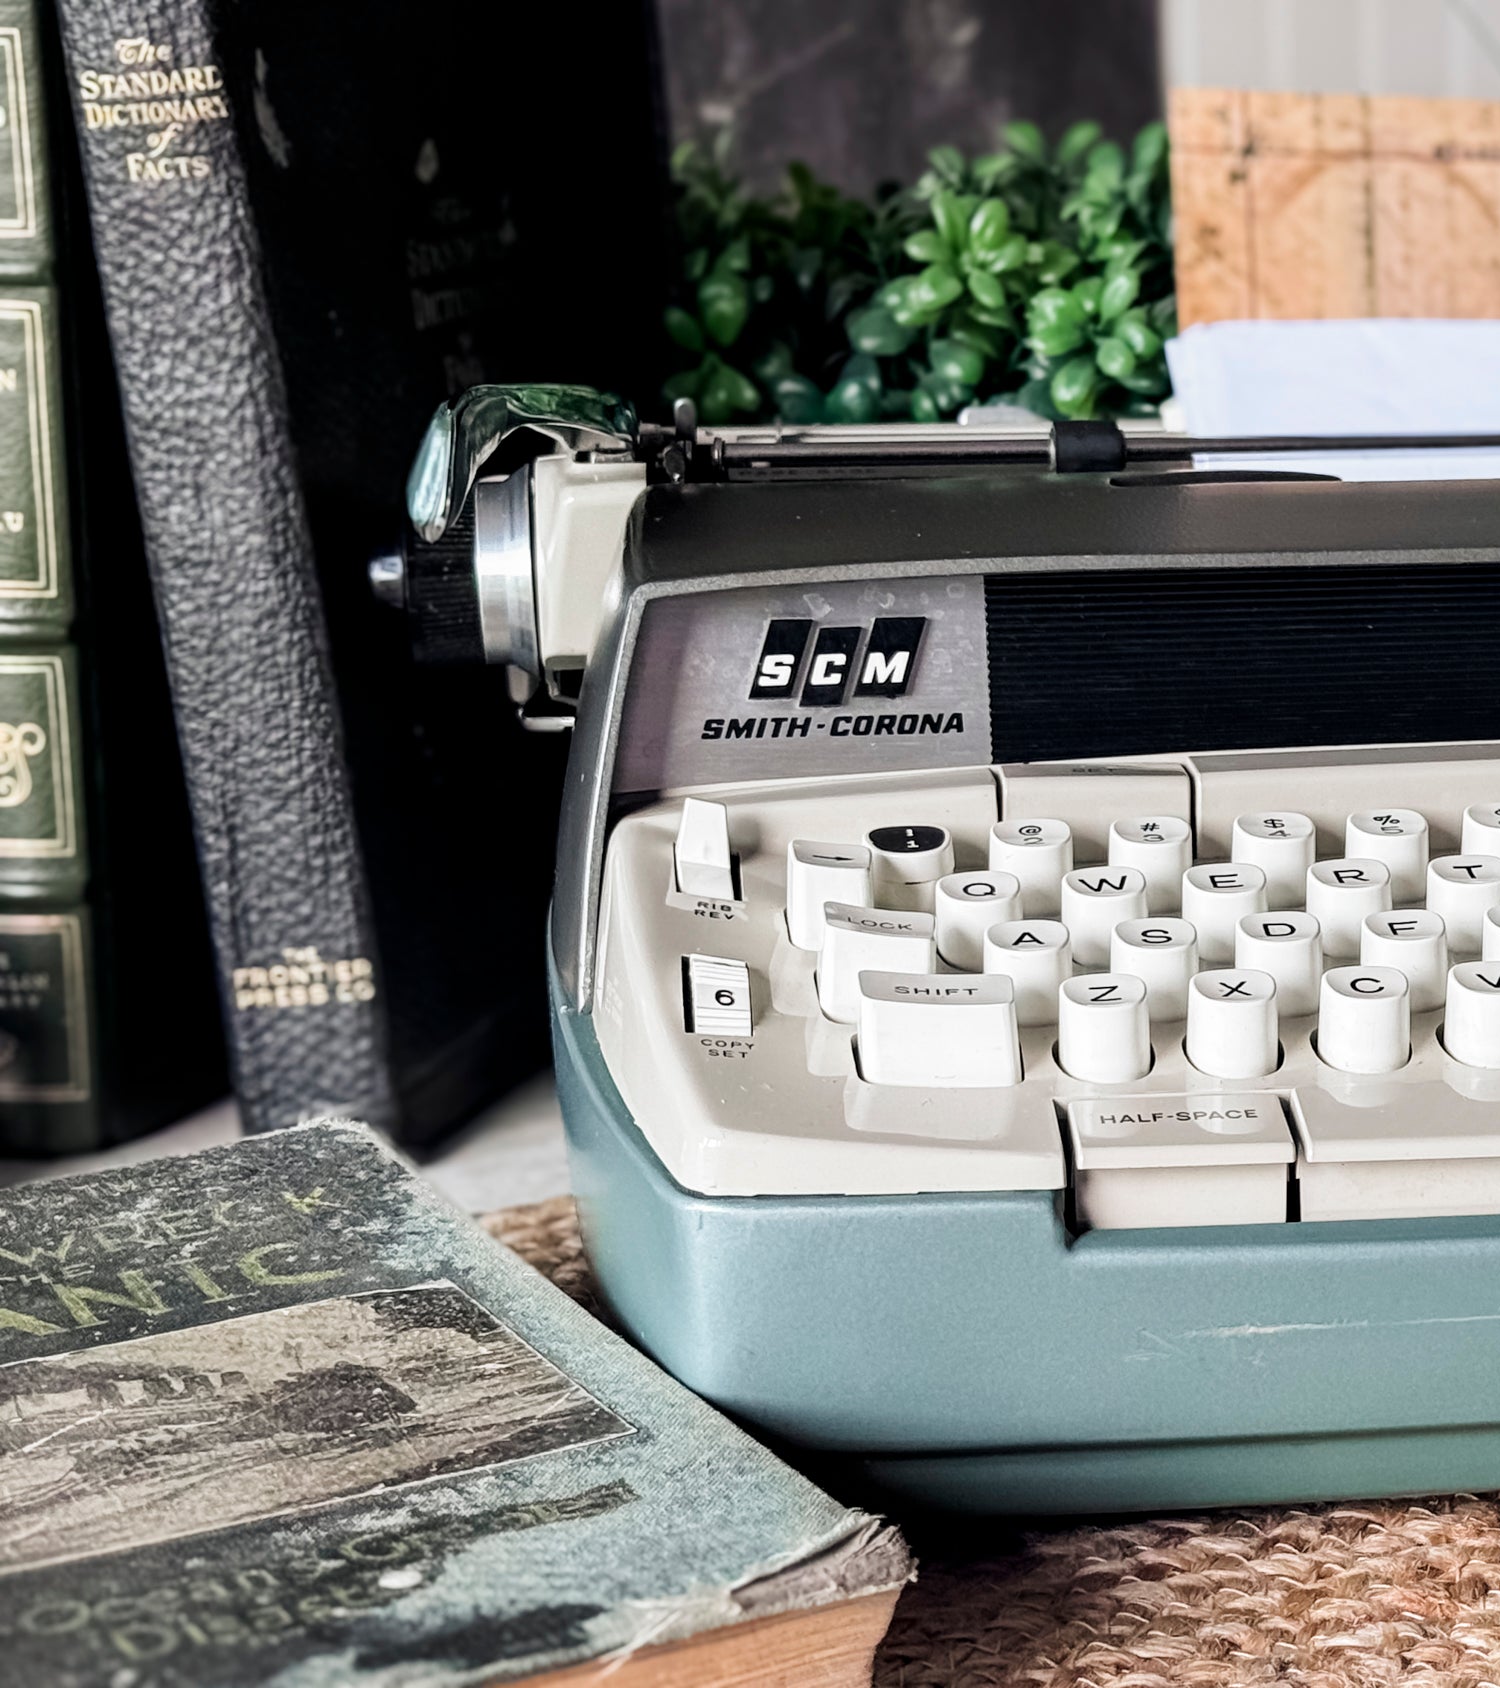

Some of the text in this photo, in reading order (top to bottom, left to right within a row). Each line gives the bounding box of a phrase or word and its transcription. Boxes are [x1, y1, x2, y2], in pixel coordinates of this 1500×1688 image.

[115, 36, 173, 65] The
[82, 96, 229, 129] DICTIONARY
[147, 122, 184, 158] of
[126, 153, 211, 183] FACTS
[757, 651, 910, 687] SCM
[701, 712, 965, 740] SMITH-CORONA
[1018, 825, 1043, 836] @
[1333, 869, 1371, 884] R
[1452, 864, 1483, 880] T
[1078, 875, 1128, 892] W
[1209, 874, 1244, 889] E
[962, 882, 998, 898] Q
[694, 909, 735, 921] REV
[847, 915, 914, 931] LOCK
[1262, 922, 1297, 937] D
[1387, 920, 1418, 936] F
[1012, 931, 1046, 946] A
[1140, 929, 1173, 944] S
[894, 985, 979, 998] SHIFT
[1088, 985, 1123, 1001] Z
[1219, 981, 1252, 997] X
[1350, 977, 1385, 994] C
[714, 989, 736, 1006] 6
[700, 1037, 755, 1050] COPY
[708, 1048, 749, 1059] SET
[1100, 1109, 1259, 1125] HALF-SPACE
